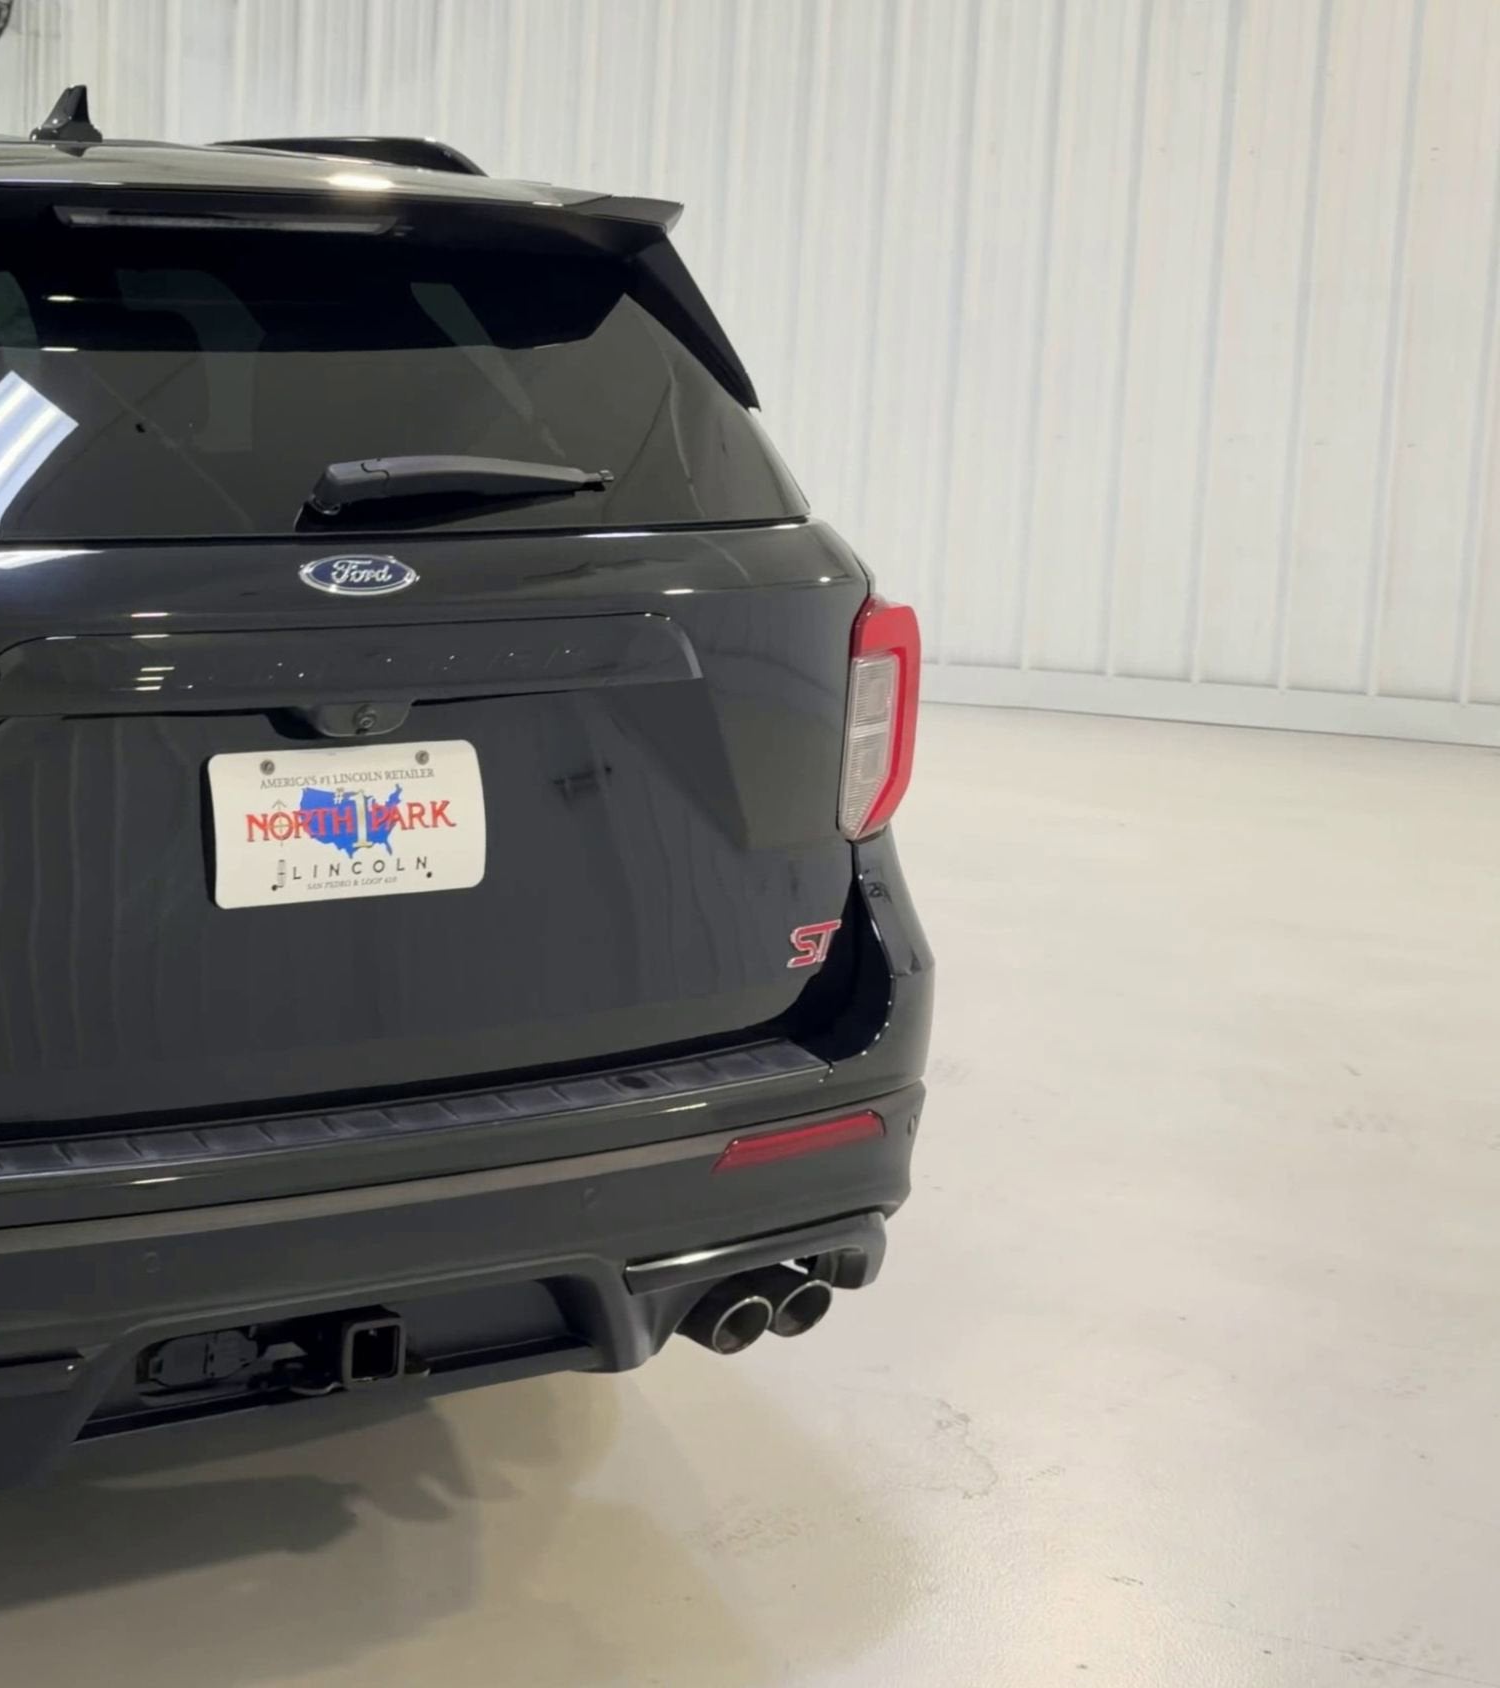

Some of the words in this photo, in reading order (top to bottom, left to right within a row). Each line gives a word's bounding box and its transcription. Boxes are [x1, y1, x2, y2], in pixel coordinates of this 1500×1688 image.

[331, 559, 393, 584] Ford
[260, 774, 317, 790] AMERICA'S
[319, 774, 331, 786] #1
[334, 770, 382, 785] LINCOLN
[385, 768, 435, 781] RETAILER
[245, 805, 356, 843] NORTH
[370, 800, 457, 832] PARK
[293, 856, 428, 880] LINCOLN
[787, 919, 842, 968] ST
